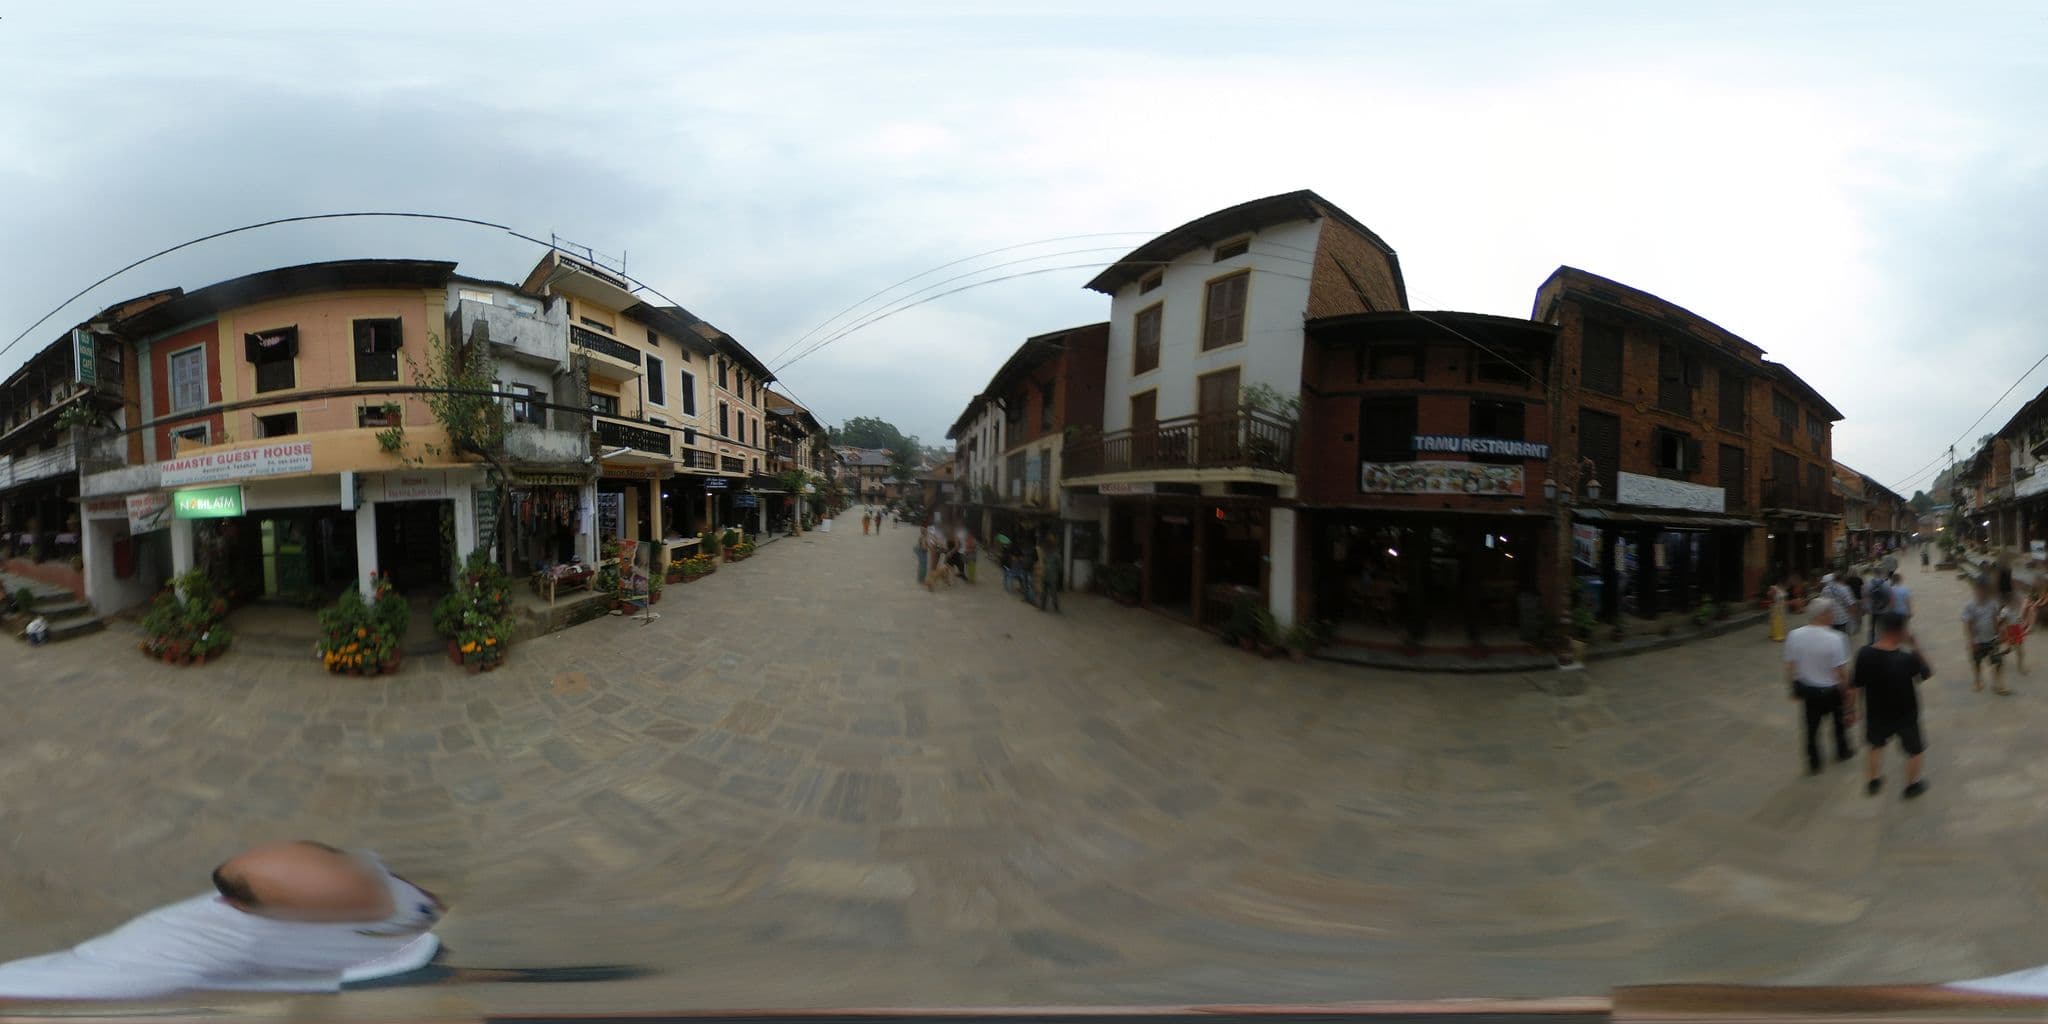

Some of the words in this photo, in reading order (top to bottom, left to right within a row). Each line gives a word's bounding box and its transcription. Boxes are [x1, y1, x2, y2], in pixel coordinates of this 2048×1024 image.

[162, 455, 213, 473] NAMASTE
[217, 450, 258, 464] GUEST
[263, 444, 312, 458] HOUSE
[1415, 436, 1459, 451] TAMU
[1461, 438, 1549, 458] RESTAURANT
